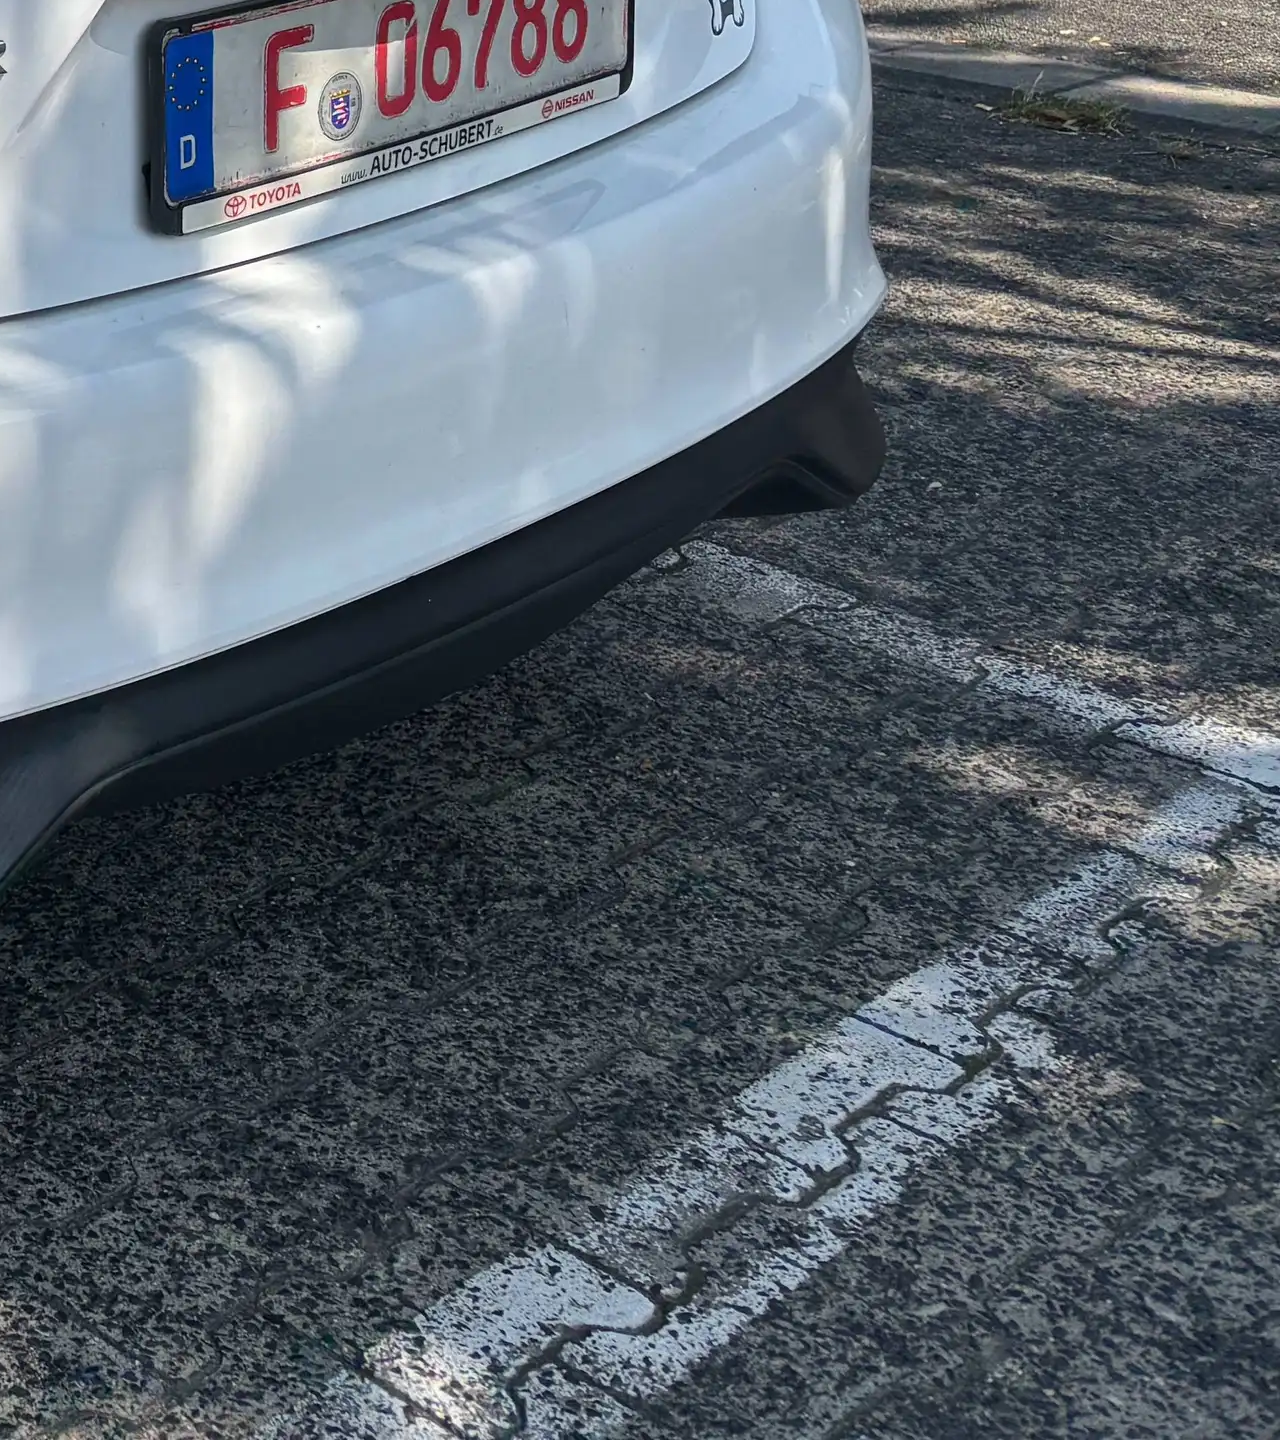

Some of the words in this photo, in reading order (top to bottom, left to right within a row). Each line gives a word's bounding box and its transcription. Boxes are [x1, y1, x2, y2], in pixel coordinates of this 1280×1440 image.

[263, 23, 315, 154] F
[554, 89, 595, 112] NISSAN
[180, 133, 197, 170] D
[249, 181, 301, 210] TOYOTA
